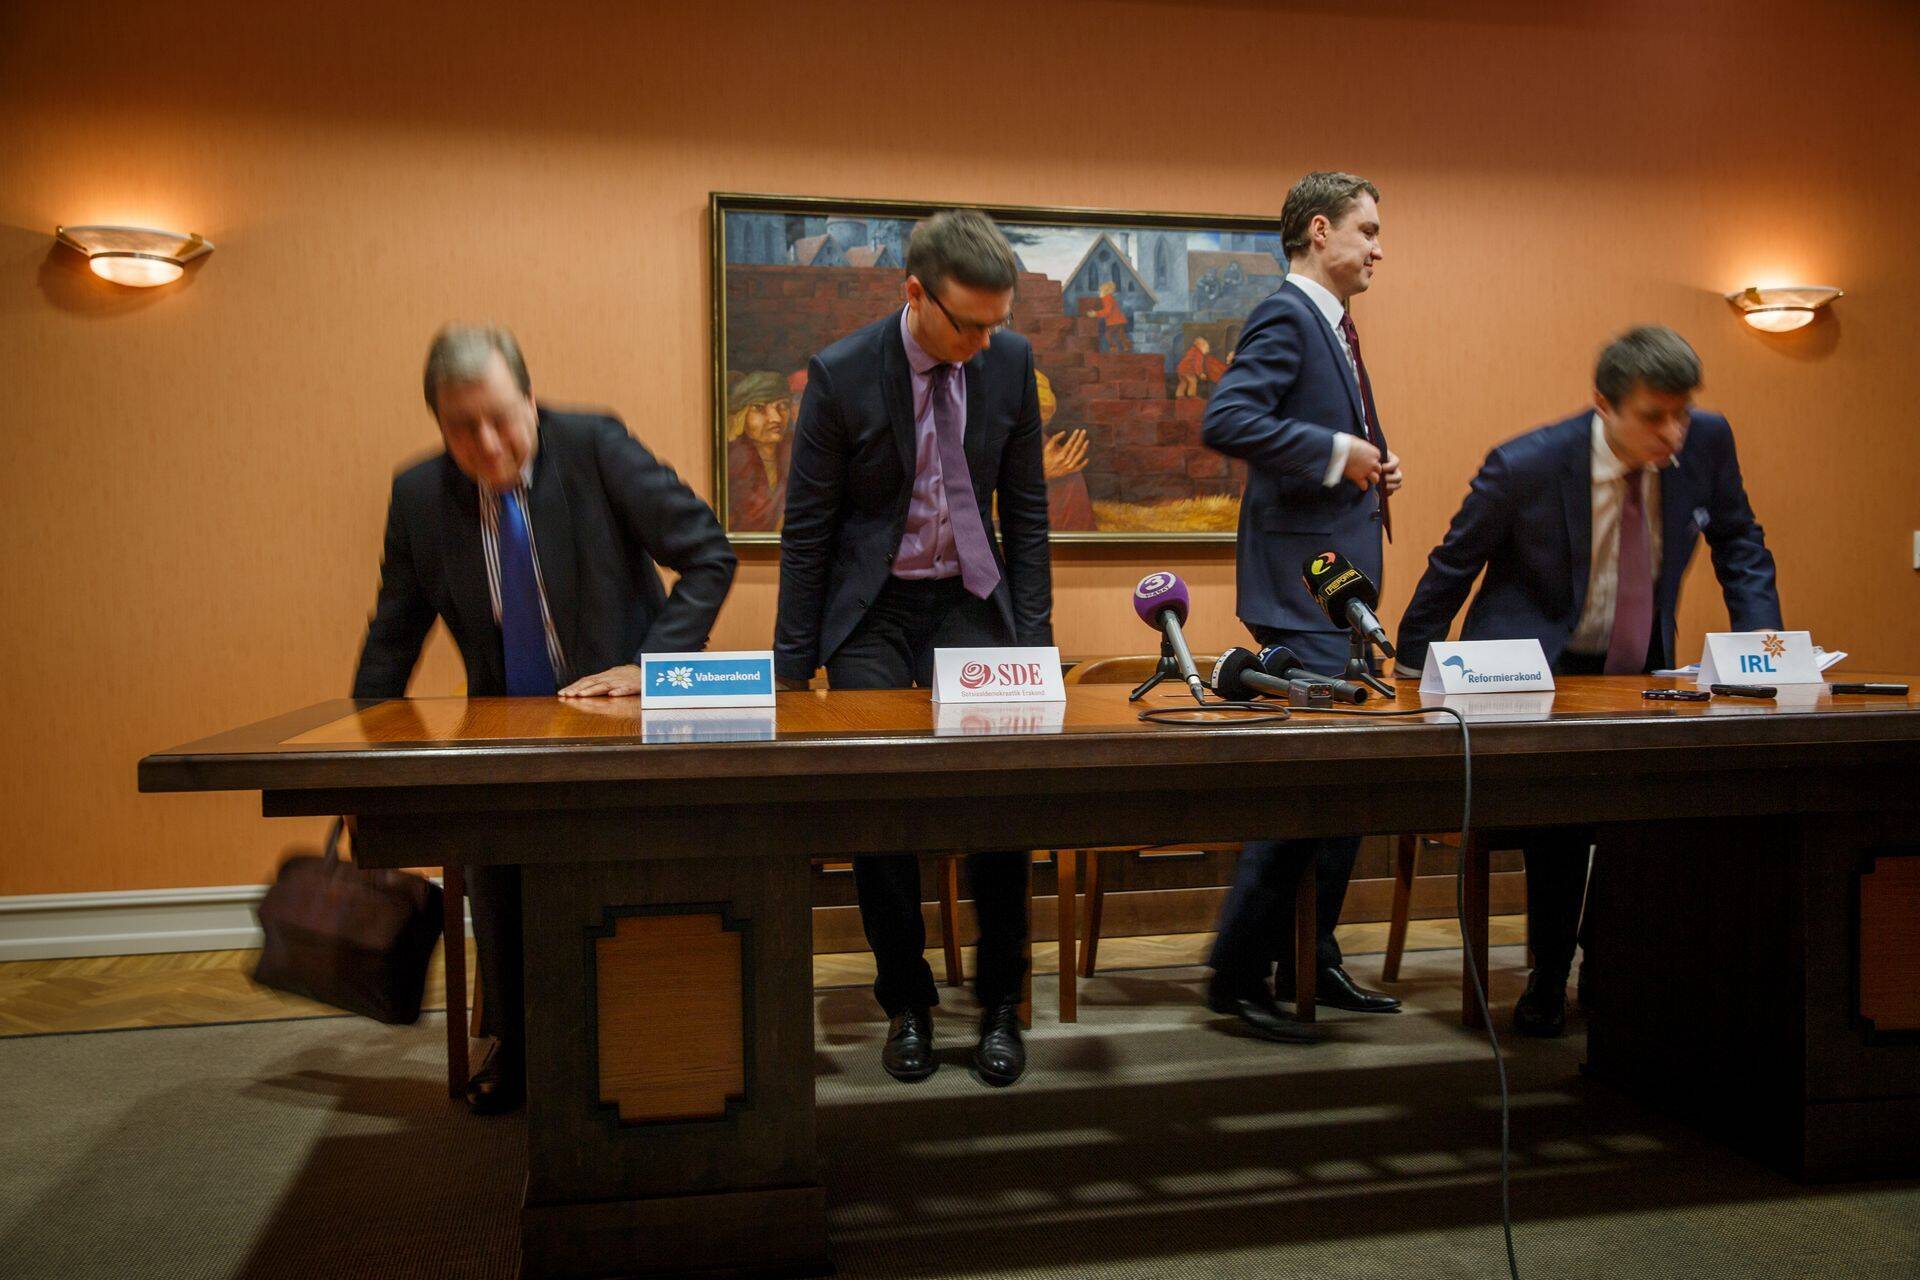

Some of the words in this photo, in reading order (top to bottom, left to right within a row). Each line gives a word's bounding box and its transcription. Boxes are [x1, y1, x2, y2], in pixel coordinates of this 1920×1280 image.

[1740, 654, 1777, 673] IRL
[695, 671, 761, 682] Vabaerakond
[997, 663, 1043, 686] SDE
[1468, 671, 1542, 683] Reformierakond
